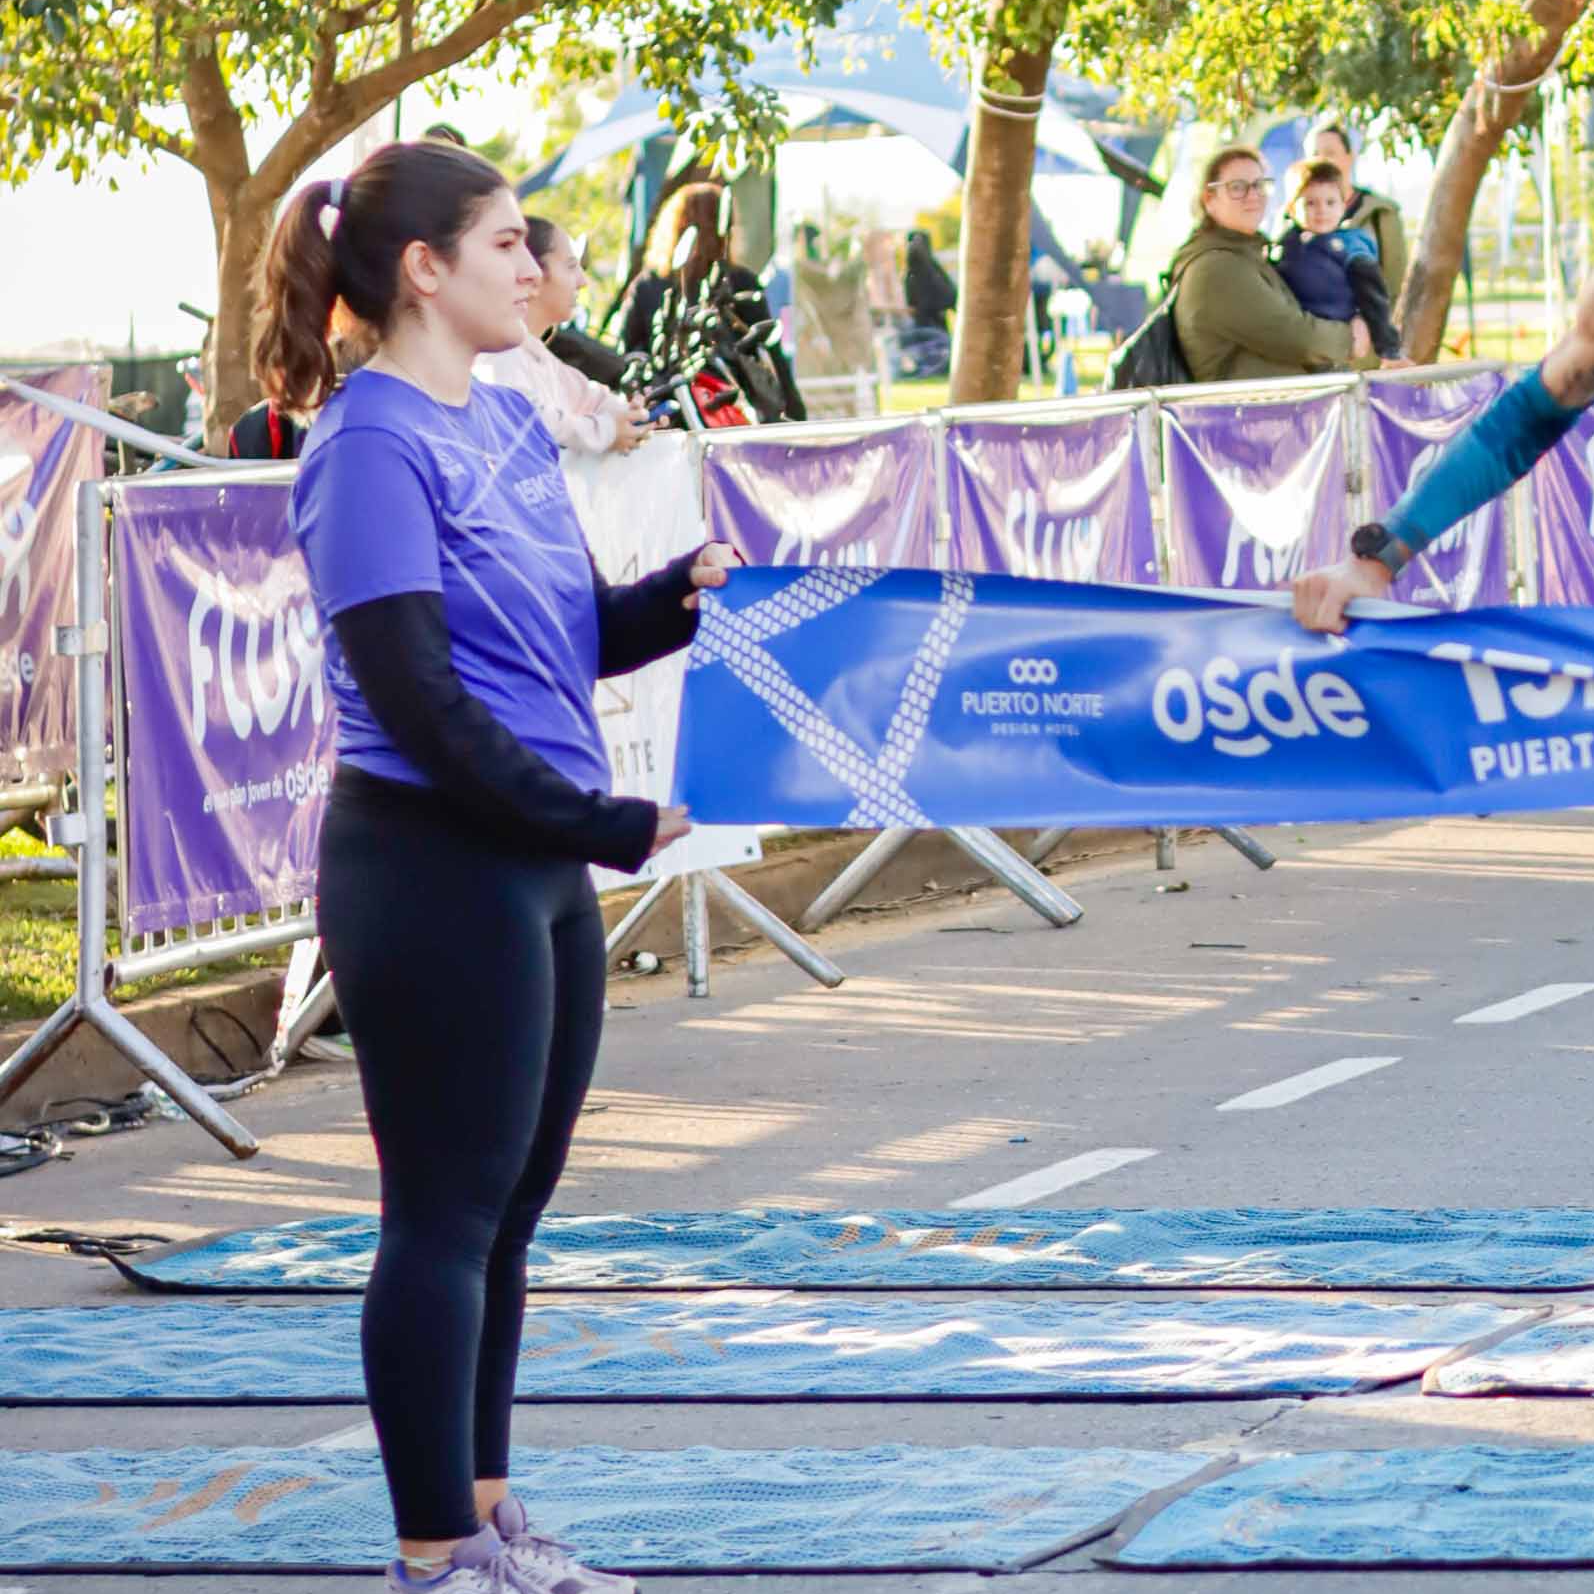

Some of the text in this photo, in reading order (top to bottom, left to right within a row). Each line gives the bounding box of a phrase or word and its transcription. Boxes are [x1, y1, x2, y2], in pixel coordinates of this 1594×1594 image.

[962, 691, 1104, 719] PUERTO NORTE
[1152, 646, 1370, 745] osde
[285, 755, 330, 805] osde
